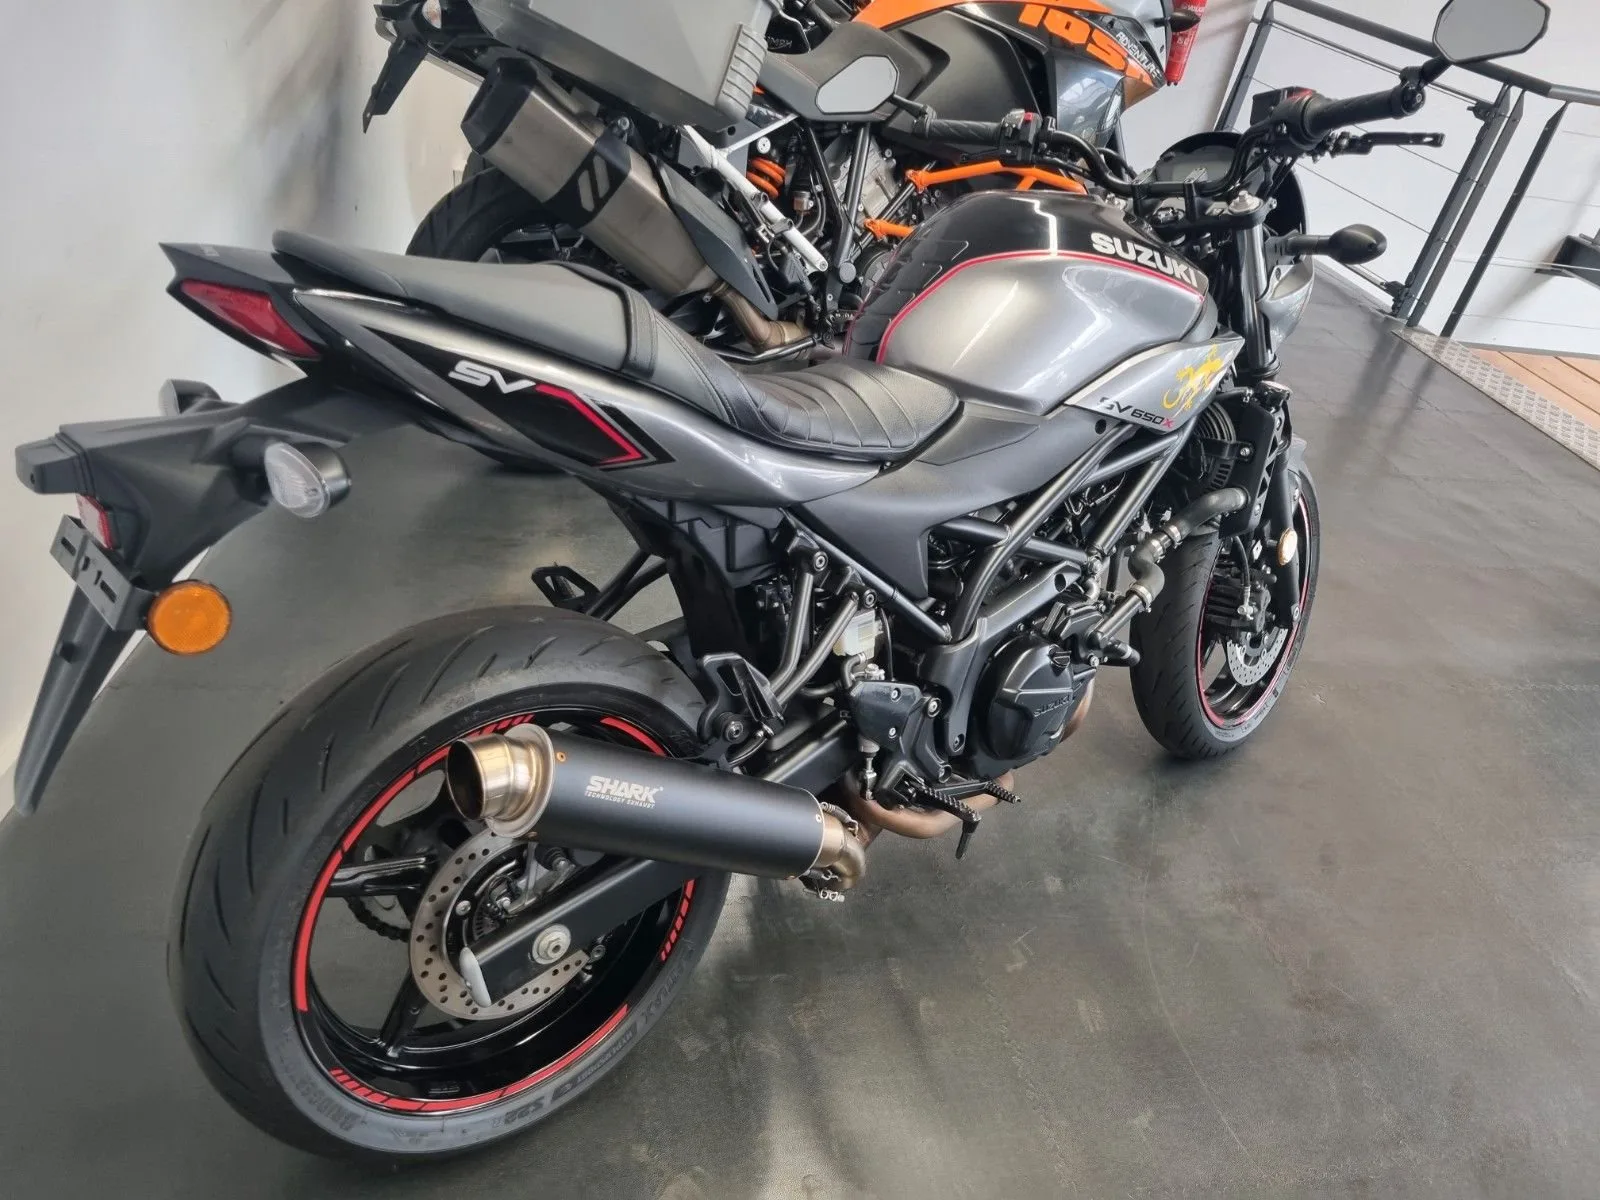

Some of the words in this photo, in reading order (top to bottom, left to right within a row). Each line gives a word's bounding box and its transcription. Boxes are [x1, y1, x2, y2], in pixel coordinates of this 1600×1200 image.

[1115, 31, 1163, 79] ADVENTURE
[1090, 232, 1199, 288] SUZUKI
[448, 359, 537, 394] SV
[1034, 695, 1072, 717] SUZUKI
[584, 790, 626, 804] TECHNOLOGY
[586, 775, 656, 804] SHARK
